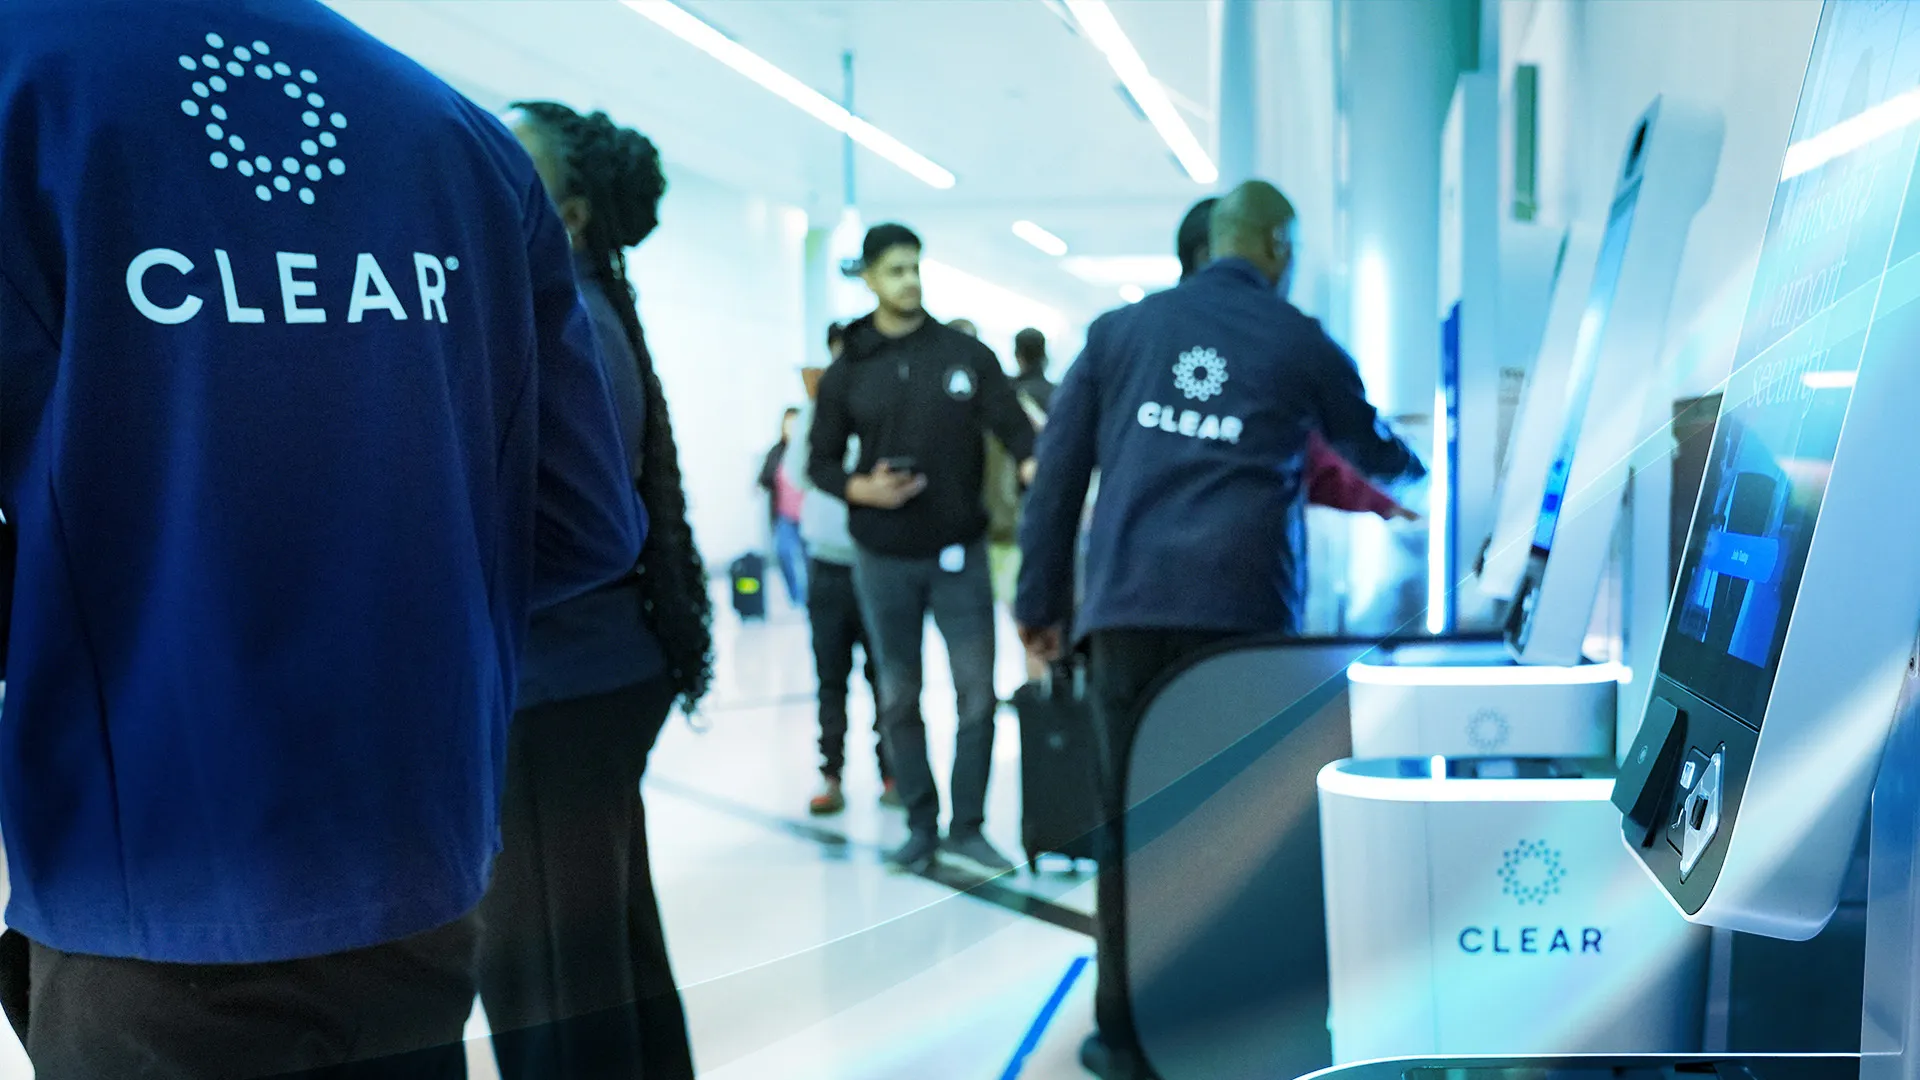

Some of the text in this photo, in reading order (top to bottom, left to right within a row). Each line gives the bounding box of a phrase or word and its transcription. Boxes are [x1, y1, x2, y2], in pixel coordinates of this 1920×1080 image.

[1771, 256, 1848, 329] airport
[1747, 335, 1830, 419] security
[1137, 401, 1243, 444] CLEAR
[1458, 926, 1603, 954] CLEAR
